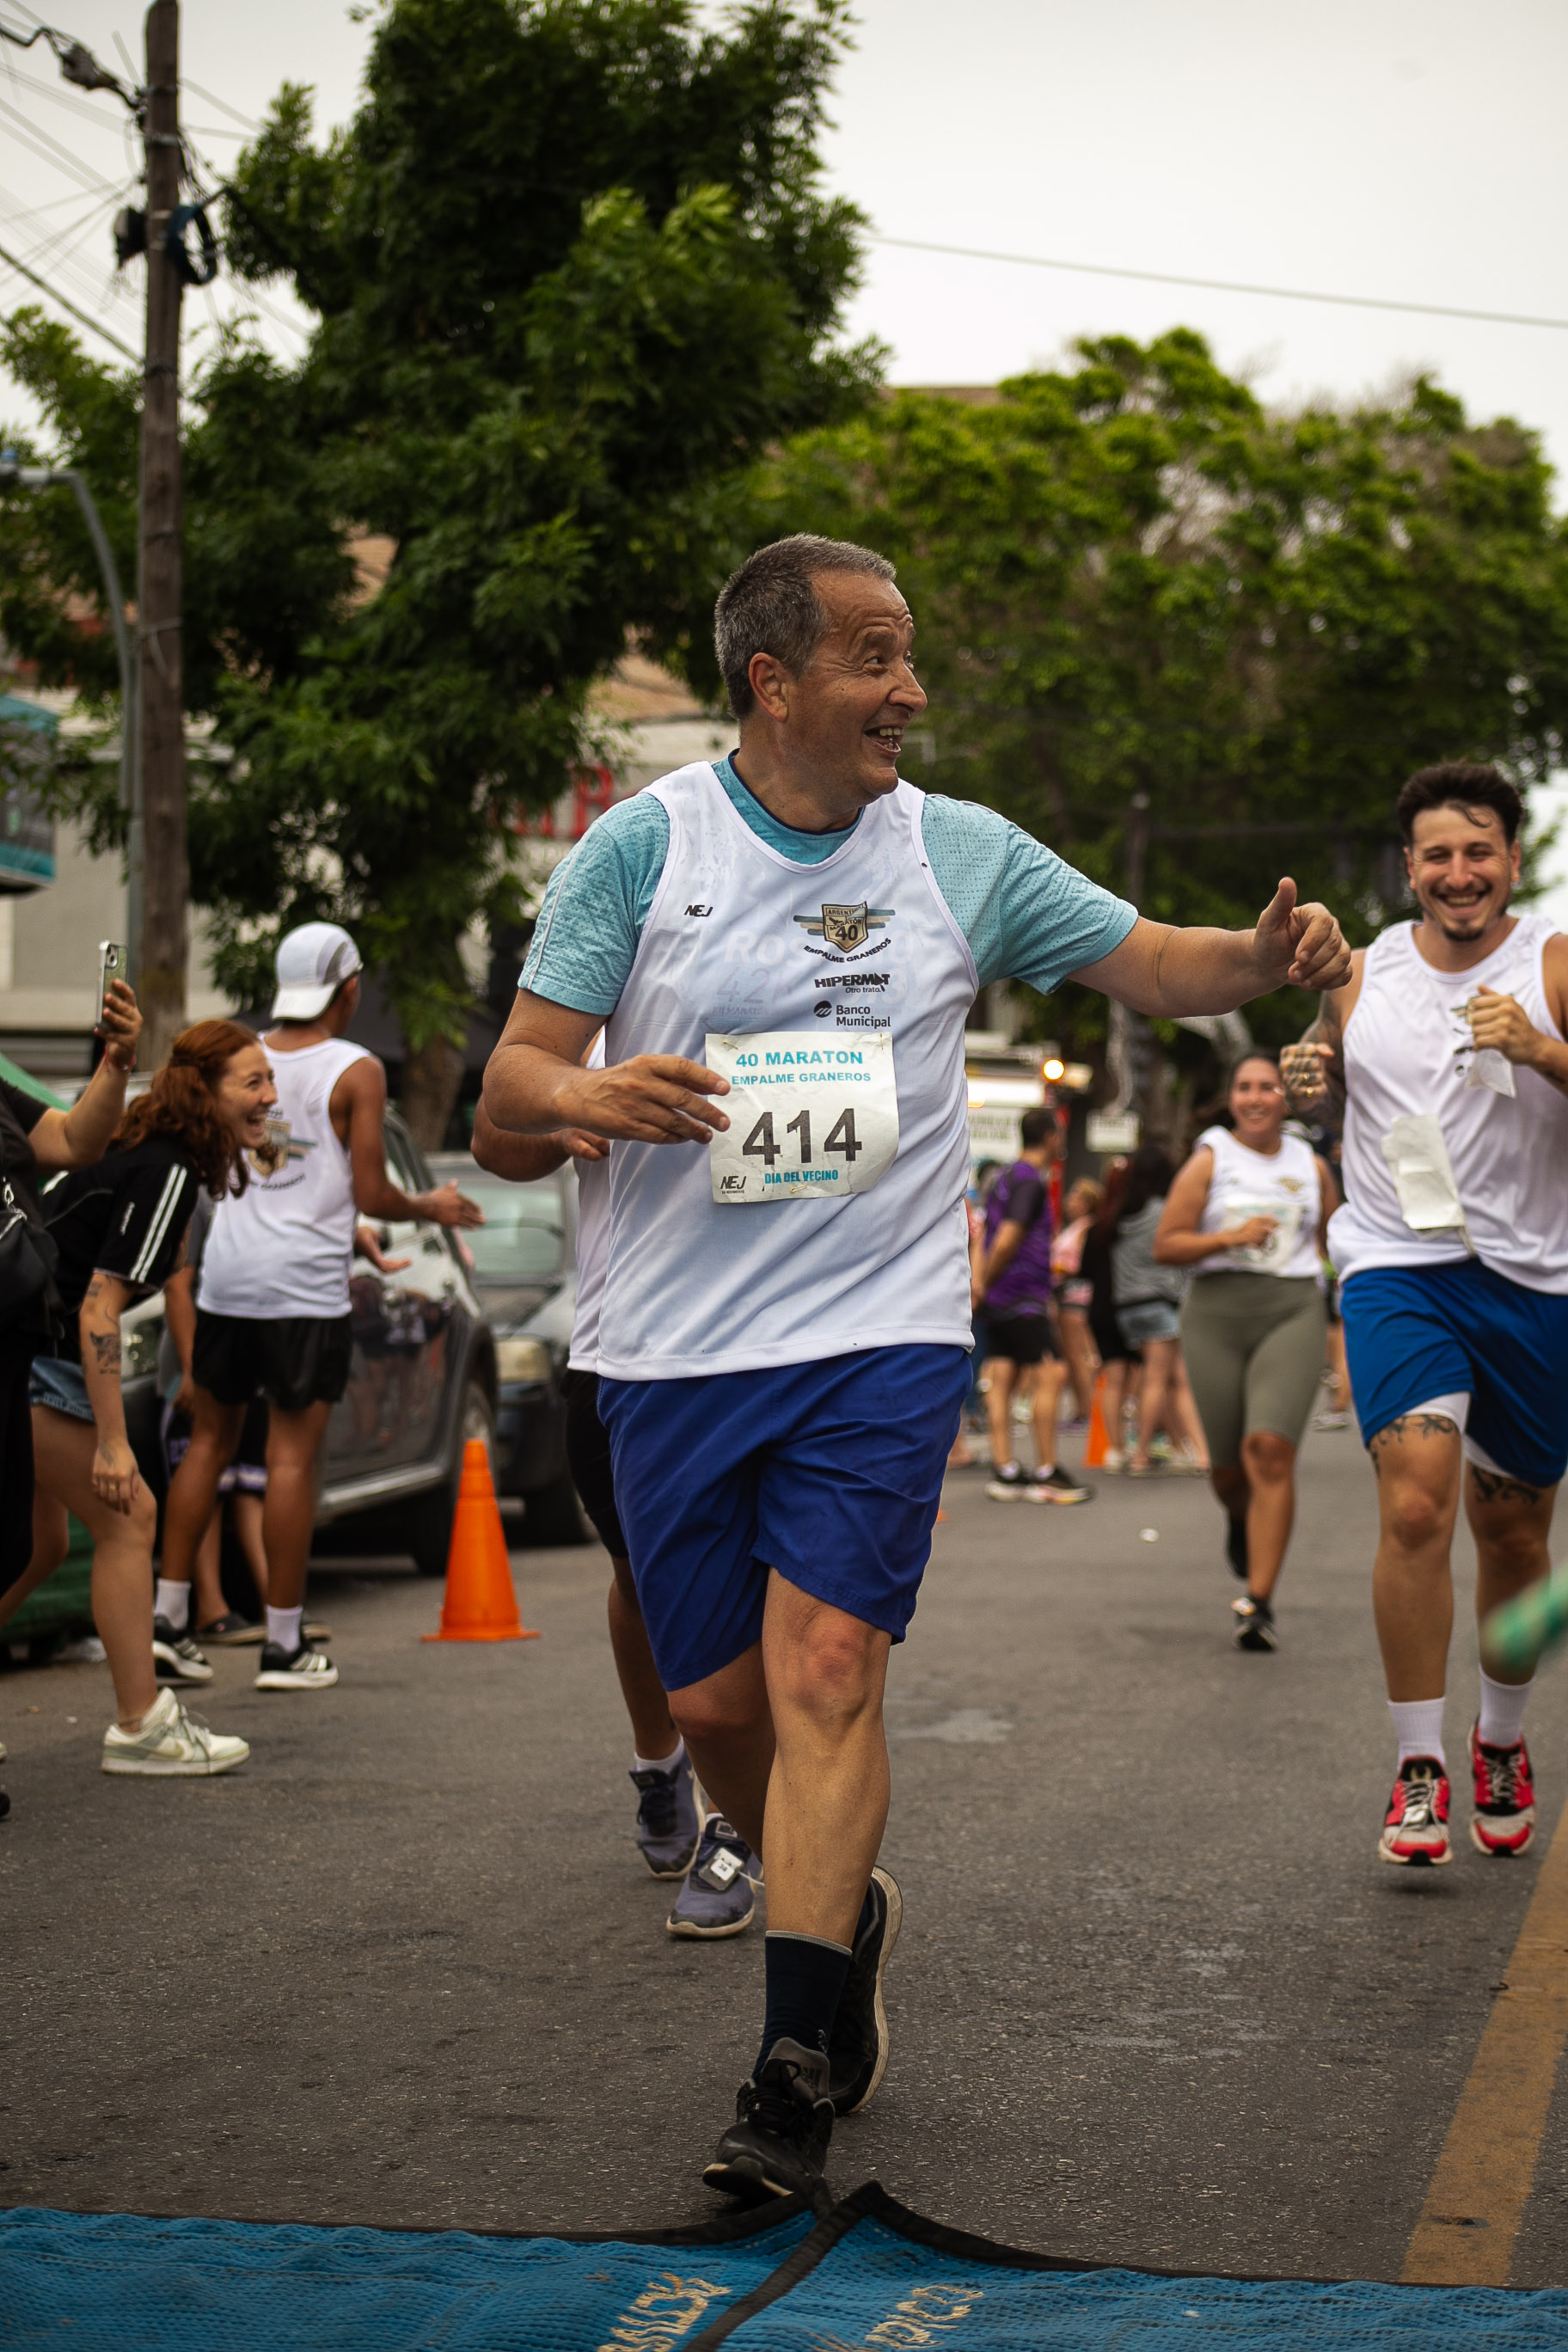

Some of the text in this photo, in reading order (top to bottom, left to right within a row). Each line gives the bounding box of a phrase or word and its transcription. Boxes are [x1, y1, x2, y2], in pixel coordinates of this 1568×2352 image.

[683, 904, 714, 917] NEJ
[835, 924, 859, 941] 40
[803, 937, 892, 964] EMPALME GRANEROS
[836, 1004, 871, 1015] Banco
[836, 1015, 891, 1030] Municipal
[736, 1050, 863, 1068] 40 MARATON
[732, 1072, 872, 1085] EMPALME GRANEROS
[742, 1107, 862, 1166] 414
[720, 1175, 747, 1190] NEJ
[764, 1169, 839, 1185] DIA DEL VECINO
